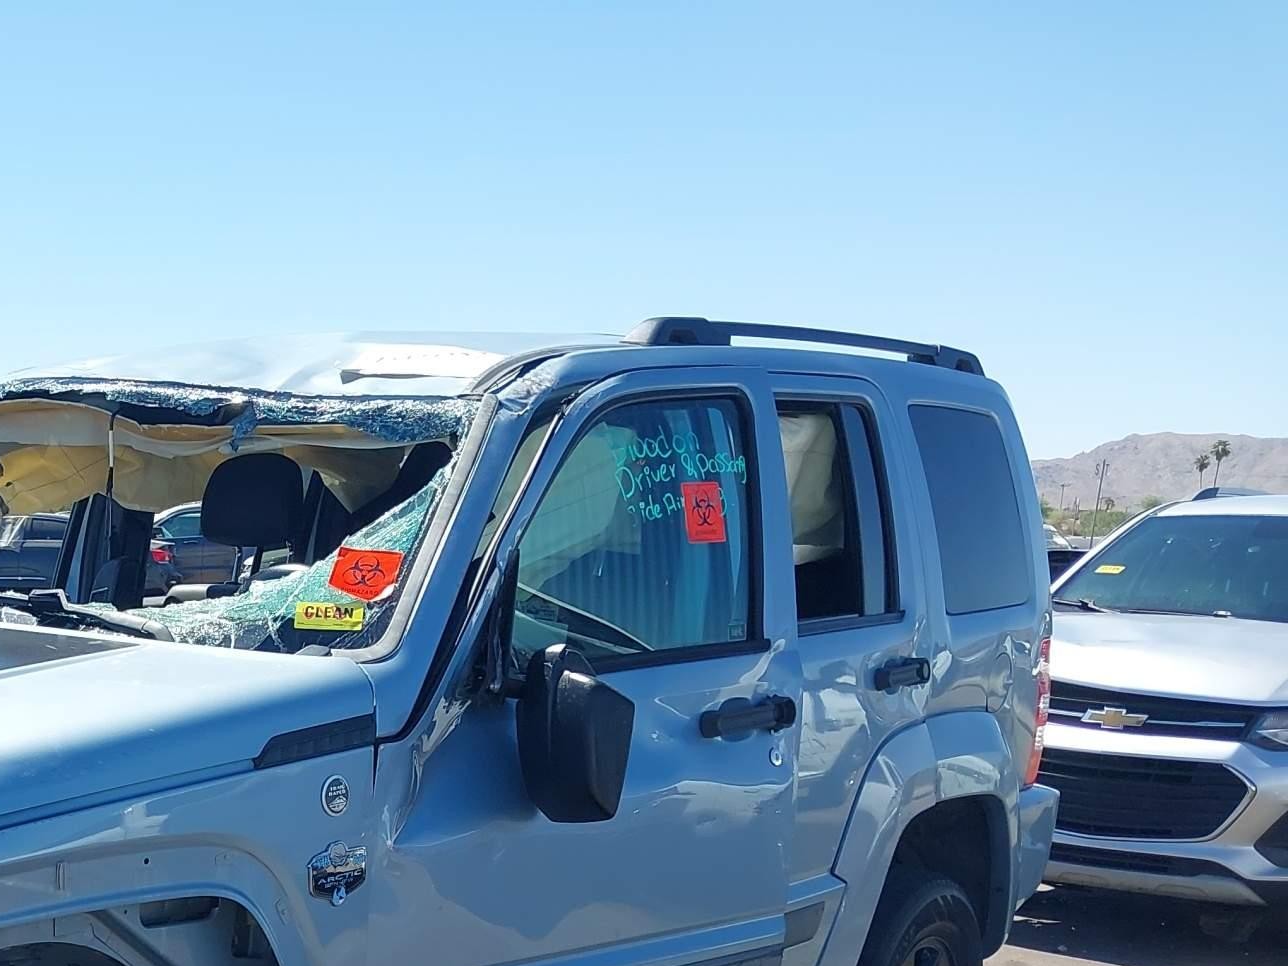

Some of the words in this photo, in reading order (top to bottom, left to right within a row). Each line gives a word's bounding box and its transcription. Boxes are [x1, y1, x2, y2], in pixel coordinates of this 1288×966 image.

[673, 432, 700, 453] on
[615, 463, 675, 501] Driver
[681, 453, 698, 479] &
[304, 606, 354, 619] CLEAN
[318, 868, 362, 885] ARCTIC
